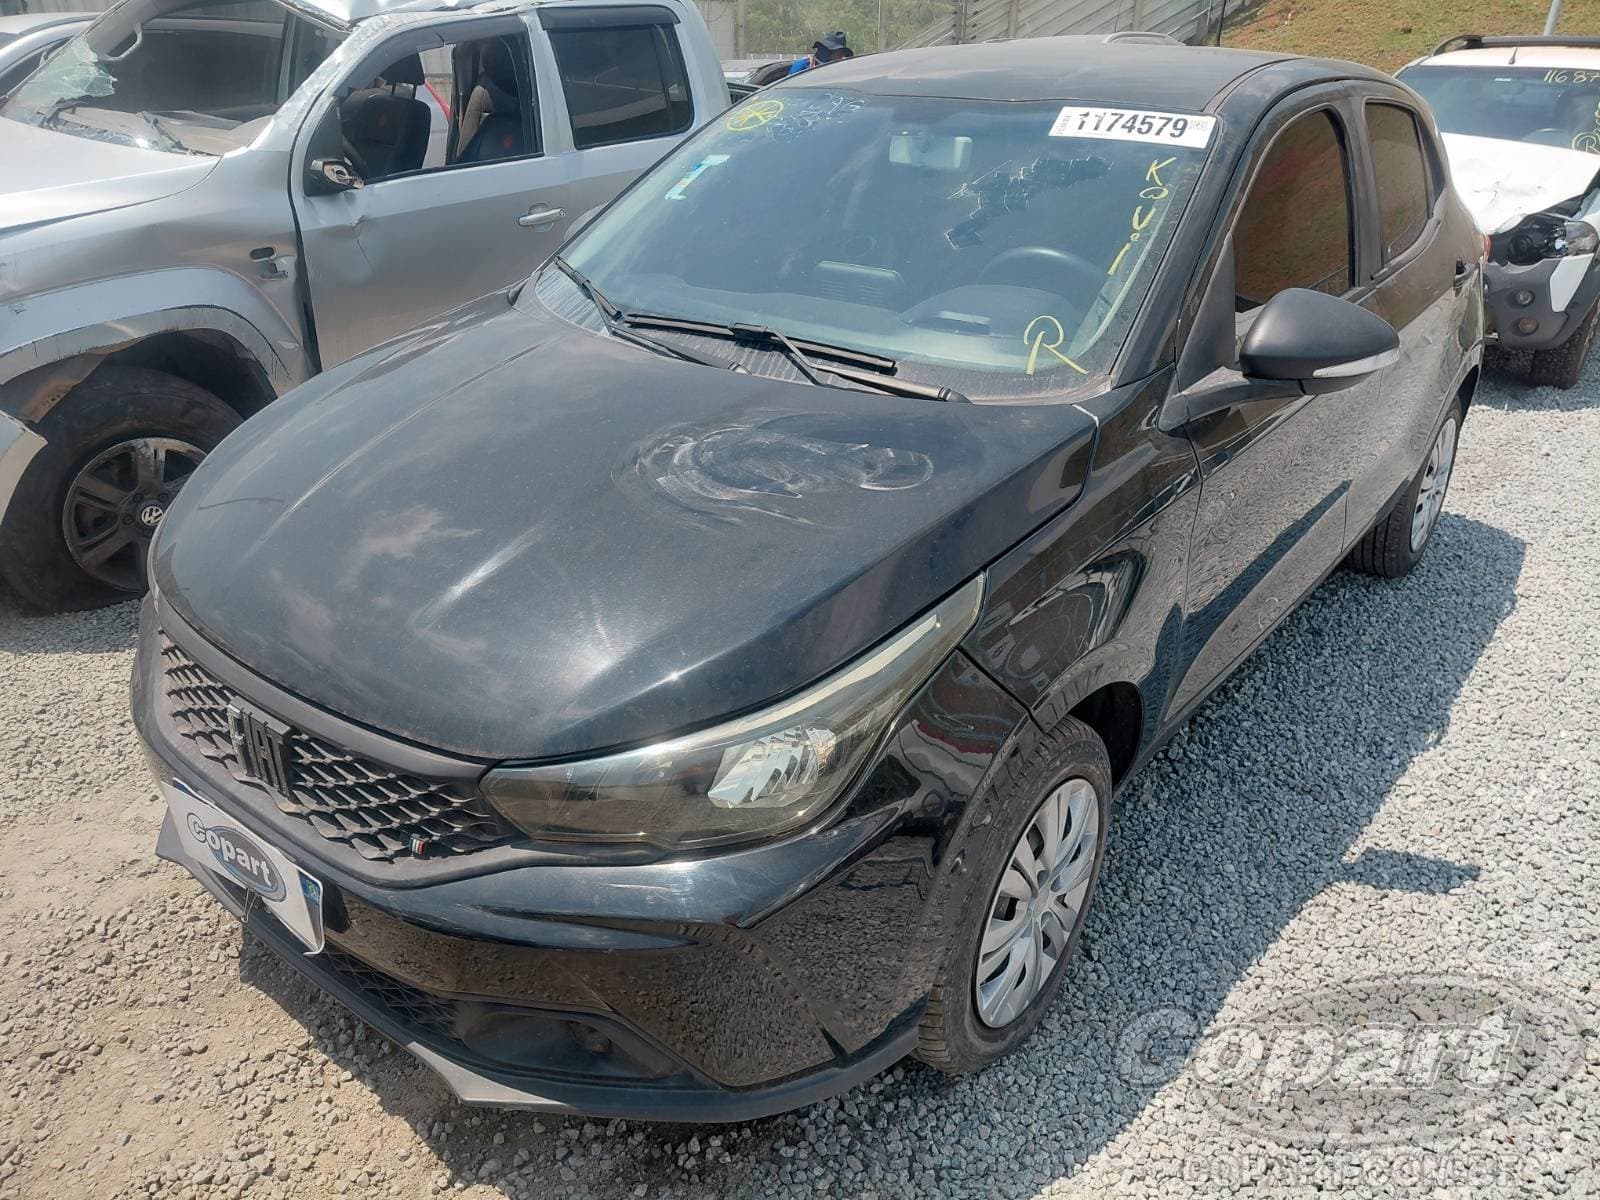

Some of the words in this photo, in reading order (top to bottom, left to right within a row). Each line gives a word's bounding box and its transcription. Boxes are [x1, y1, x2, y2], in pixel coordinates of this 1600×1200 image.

[1077, 111, 1189, 138] 1174579
[1023, 315, 1089, 376] R
[186, 812, 274, 887] Copart
